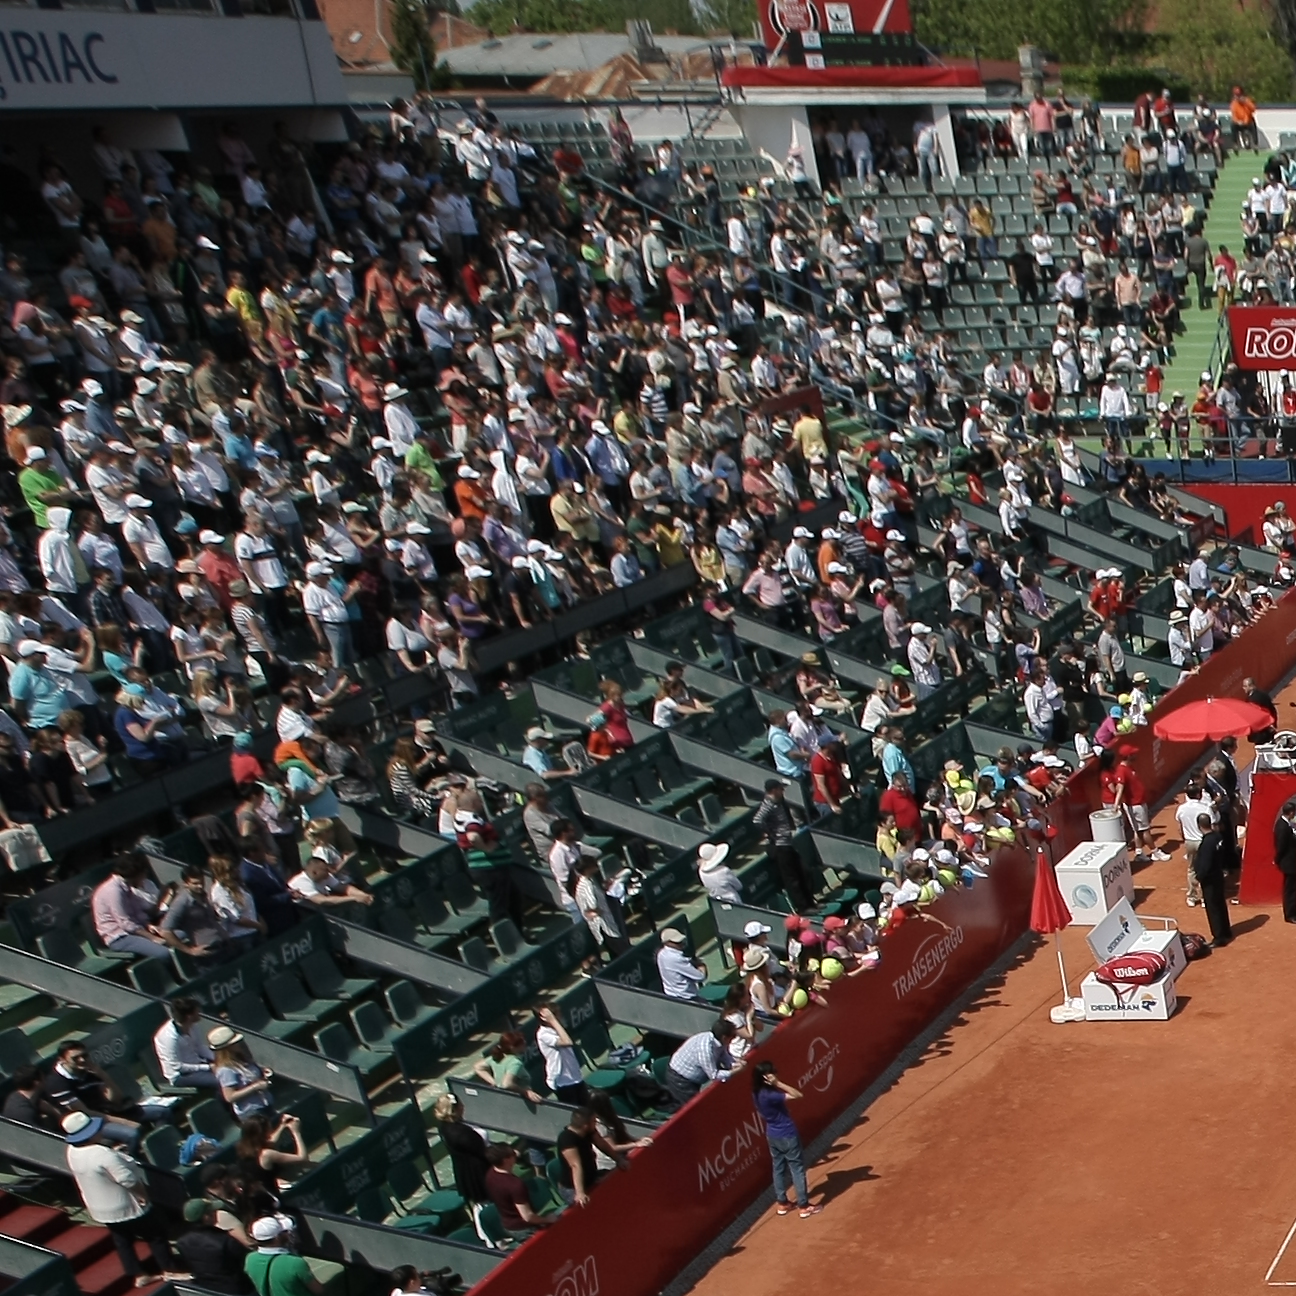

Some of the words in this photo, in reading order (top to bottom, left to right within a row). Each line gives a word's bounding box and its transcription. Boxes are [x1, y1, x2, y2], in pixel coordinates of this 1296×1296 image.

[1074, 844, 1109, 866] DORNA
[1103, 859, 1128, 889] DORNA
[280, 931, 313, 966] Enel
[892, 926, 964, 1000] TRANSENERGO
[211, 970, 245, 1004] Enel
[1114, 966, 1149, 978] Wilson
[450, 1004, 478, 1037] Enel
[570, 998, 594, 1029] Enel
